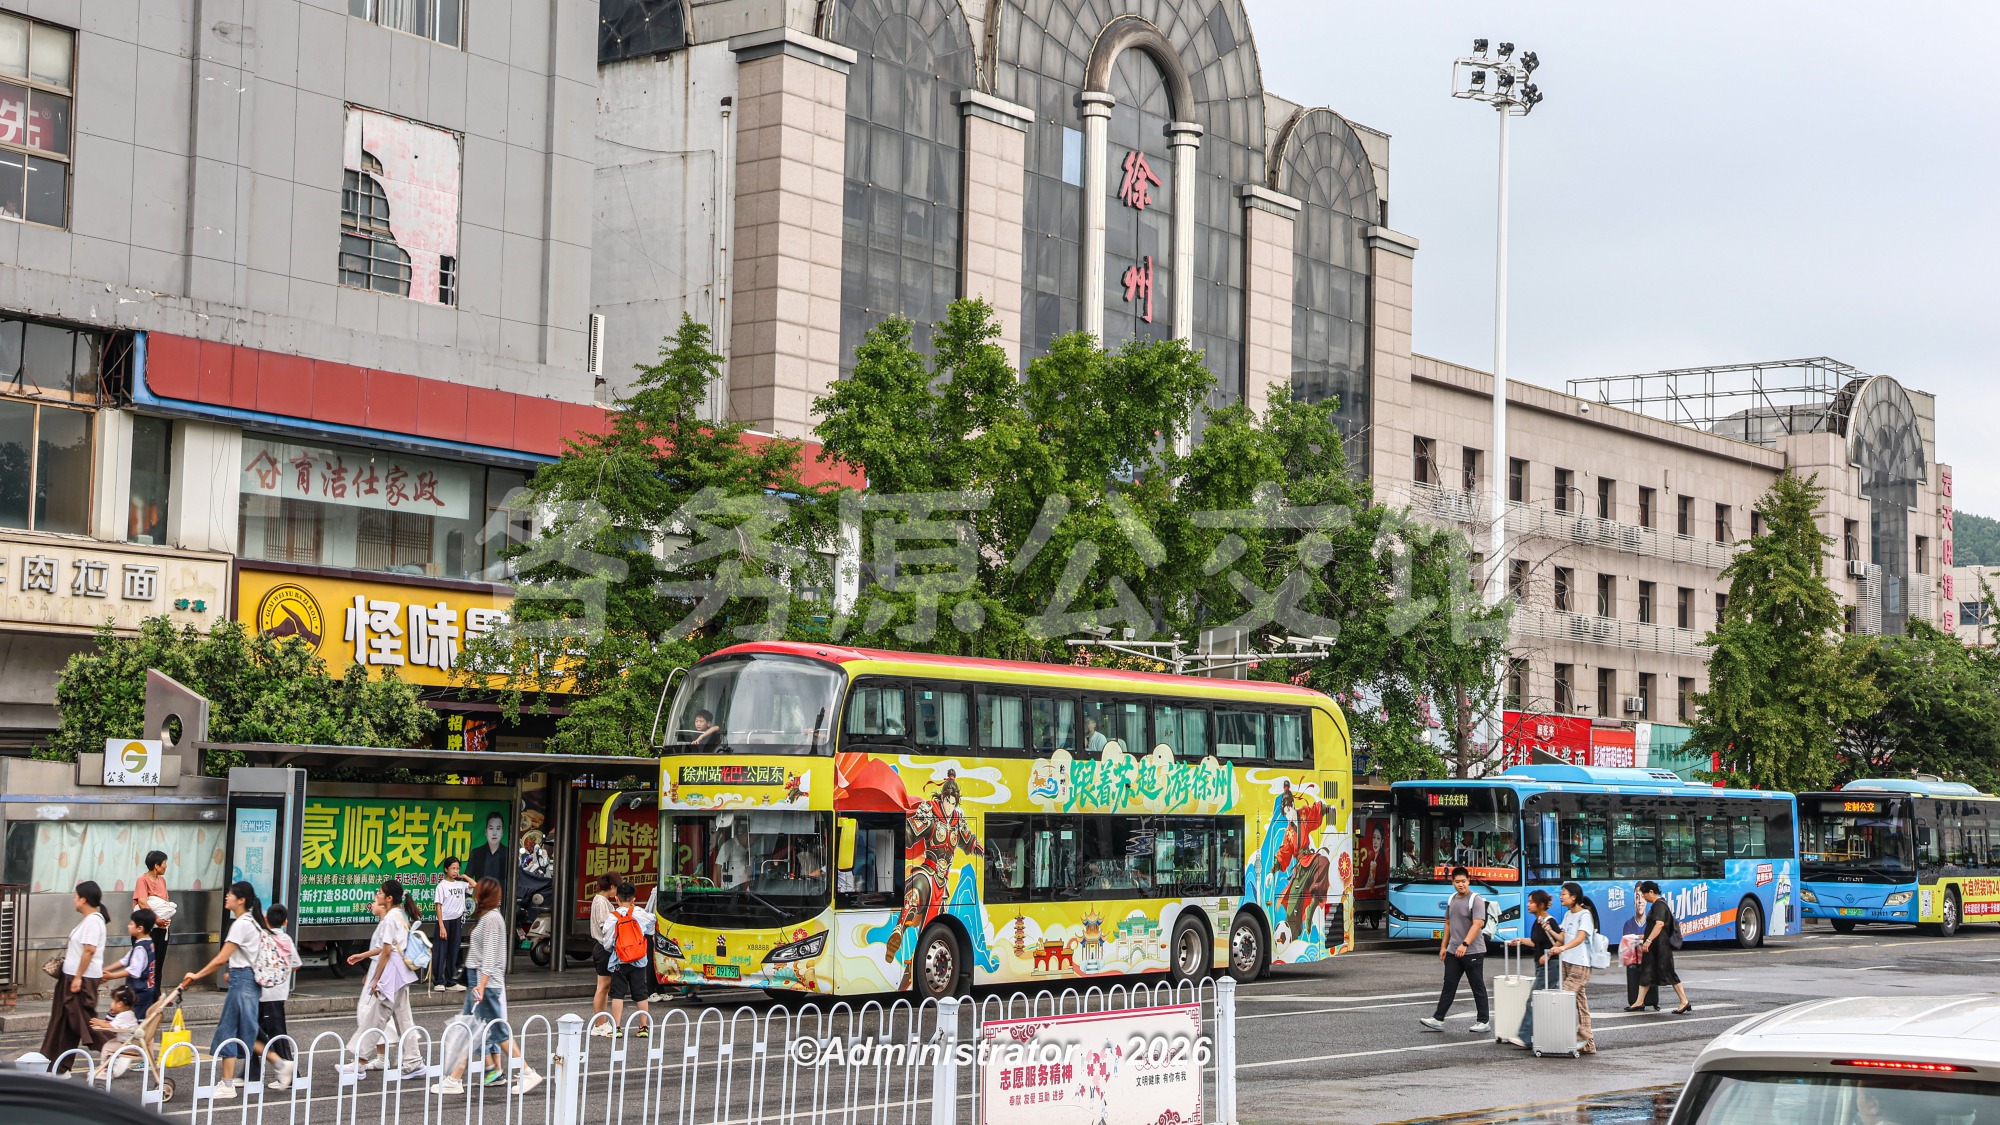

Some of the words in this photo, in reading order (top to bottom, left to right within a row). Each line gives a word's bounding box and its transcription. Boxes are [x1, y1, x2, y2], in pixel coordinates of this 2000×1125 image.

[1119, 150, 1163, 324] 徐州
[290, 451, 445, 507] 育洁仕家政
[274, 591, 285, 602] WEI
[106, 771, 126, 784] 公交
[141, 772, 159, 784] 调度
[683, 766, 722, 783] 徐州站
[747, 766, 784, 783] 公园东
[1063, 754, 1164, 814] 跟着苏超
[1165, 759, 1234, 814] 游徐州
[1844, 801, 1875, 812] 定制公交
[241, 820, 272, 834] 徐州出行
[301, 803, 474, 869] 豪顺装饰
[586, 847, 657, 877] 喝汤了
[999, 1061, 1073, 1091] 志愿服务精神
[1135, 1073, 1161, 1087] 文明健康
[1163, 1071, 1187, 1084] 有你有我
[1023, 1092, 1036, 1105] 友爱
[1038, 1091, 1050, 1103] 互助
[1052, 1089, 1065, 1101] 进步
